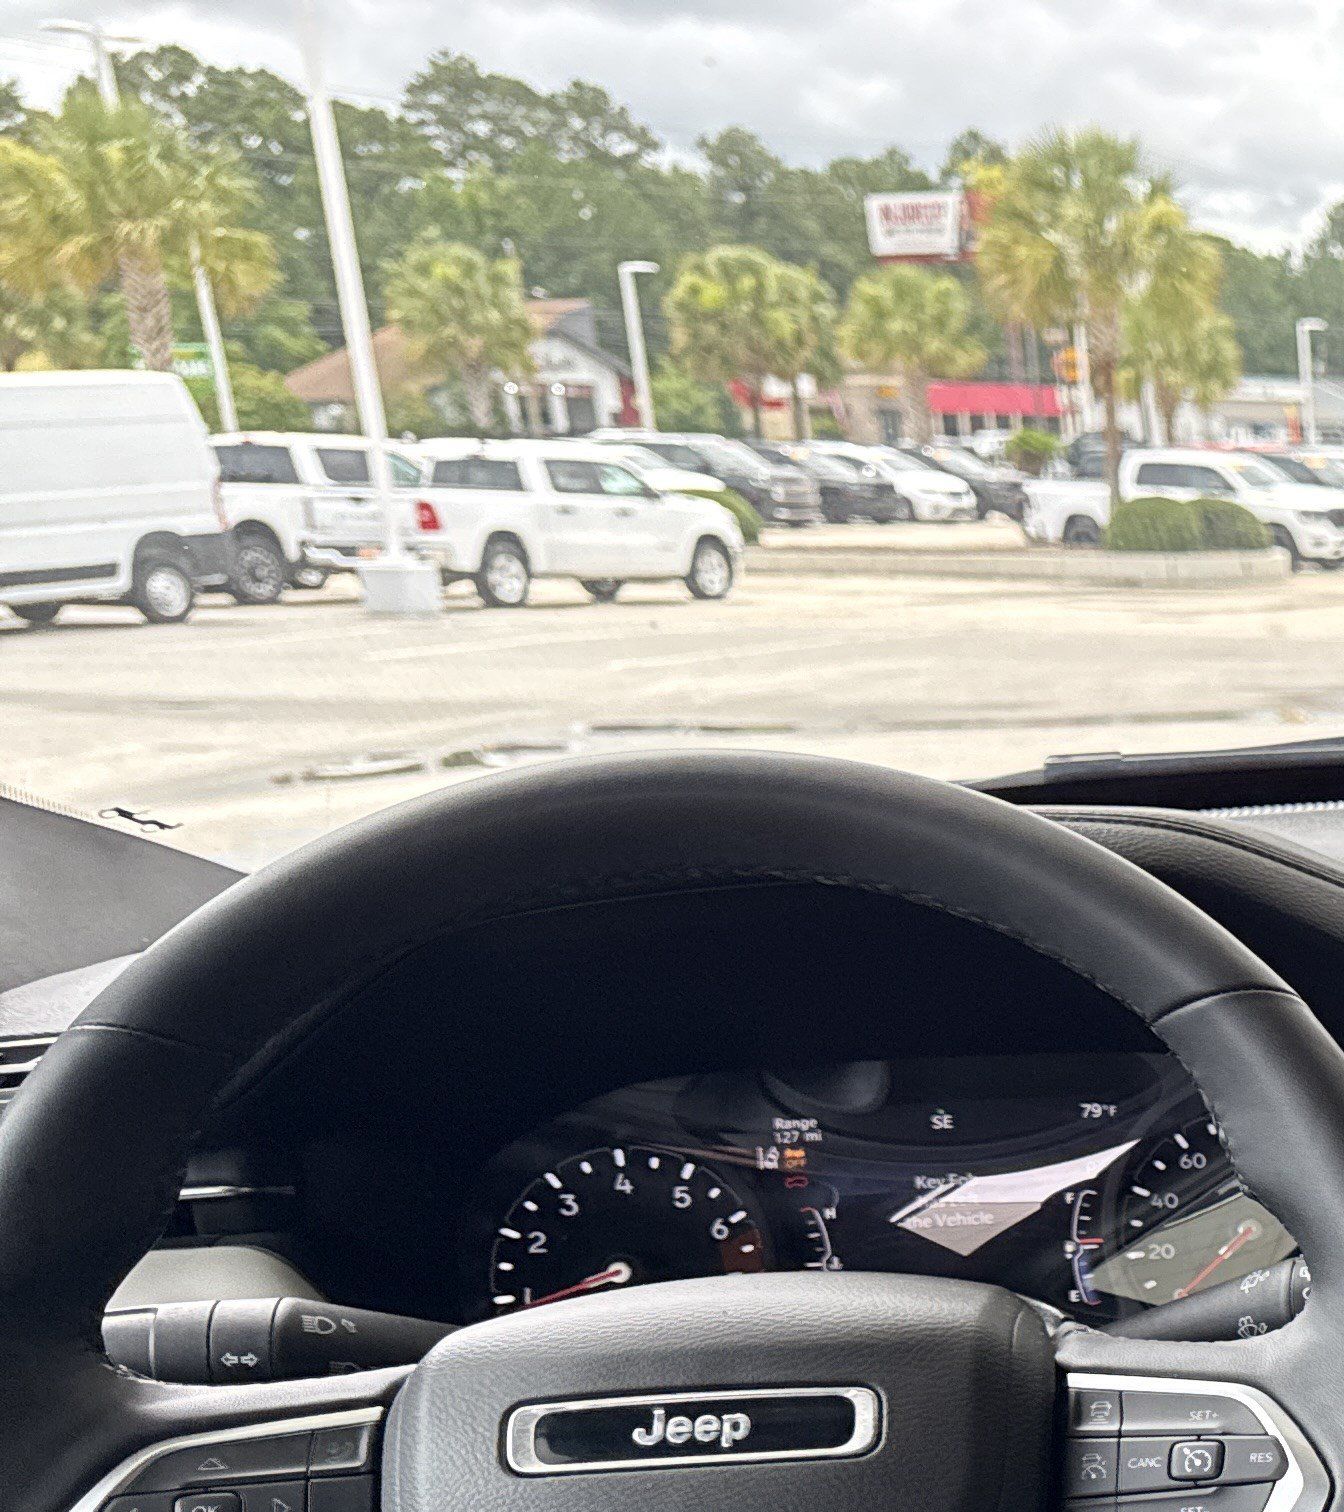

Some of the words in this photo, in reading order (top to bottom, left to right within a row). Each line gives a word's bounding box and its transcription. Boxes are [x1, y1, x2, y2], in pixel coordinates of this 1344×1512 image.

[1080, 1102, 1118, 1119] 79°F
[773, 1117, 818, 1132] Range
[930, 1113, 954, 1130] SE
[773, 1130, 800, 1143] 127
[803, 1128, 823, 1143] mi
[1179, 1152, 1207, 1169] 60
[614, 1172, 634, 1194] 4
[558, 1193, 580, 1217] 3
[672, 1186, 693, 1209] 5
[1151, 1192, 1179, 1209] 40
[934, 1209, 994, 1228] Vehicle
[710, 1218, 730, 1241] 6
[526, 1231, 549, 1254] 2
[1148, 1243, 1176, 1260] 20
[631, 1407, 751, 1448] Jeep
[1127, 1456, 1163, 1469] CANC
[1249, 1452, 1274, 1464] RES
